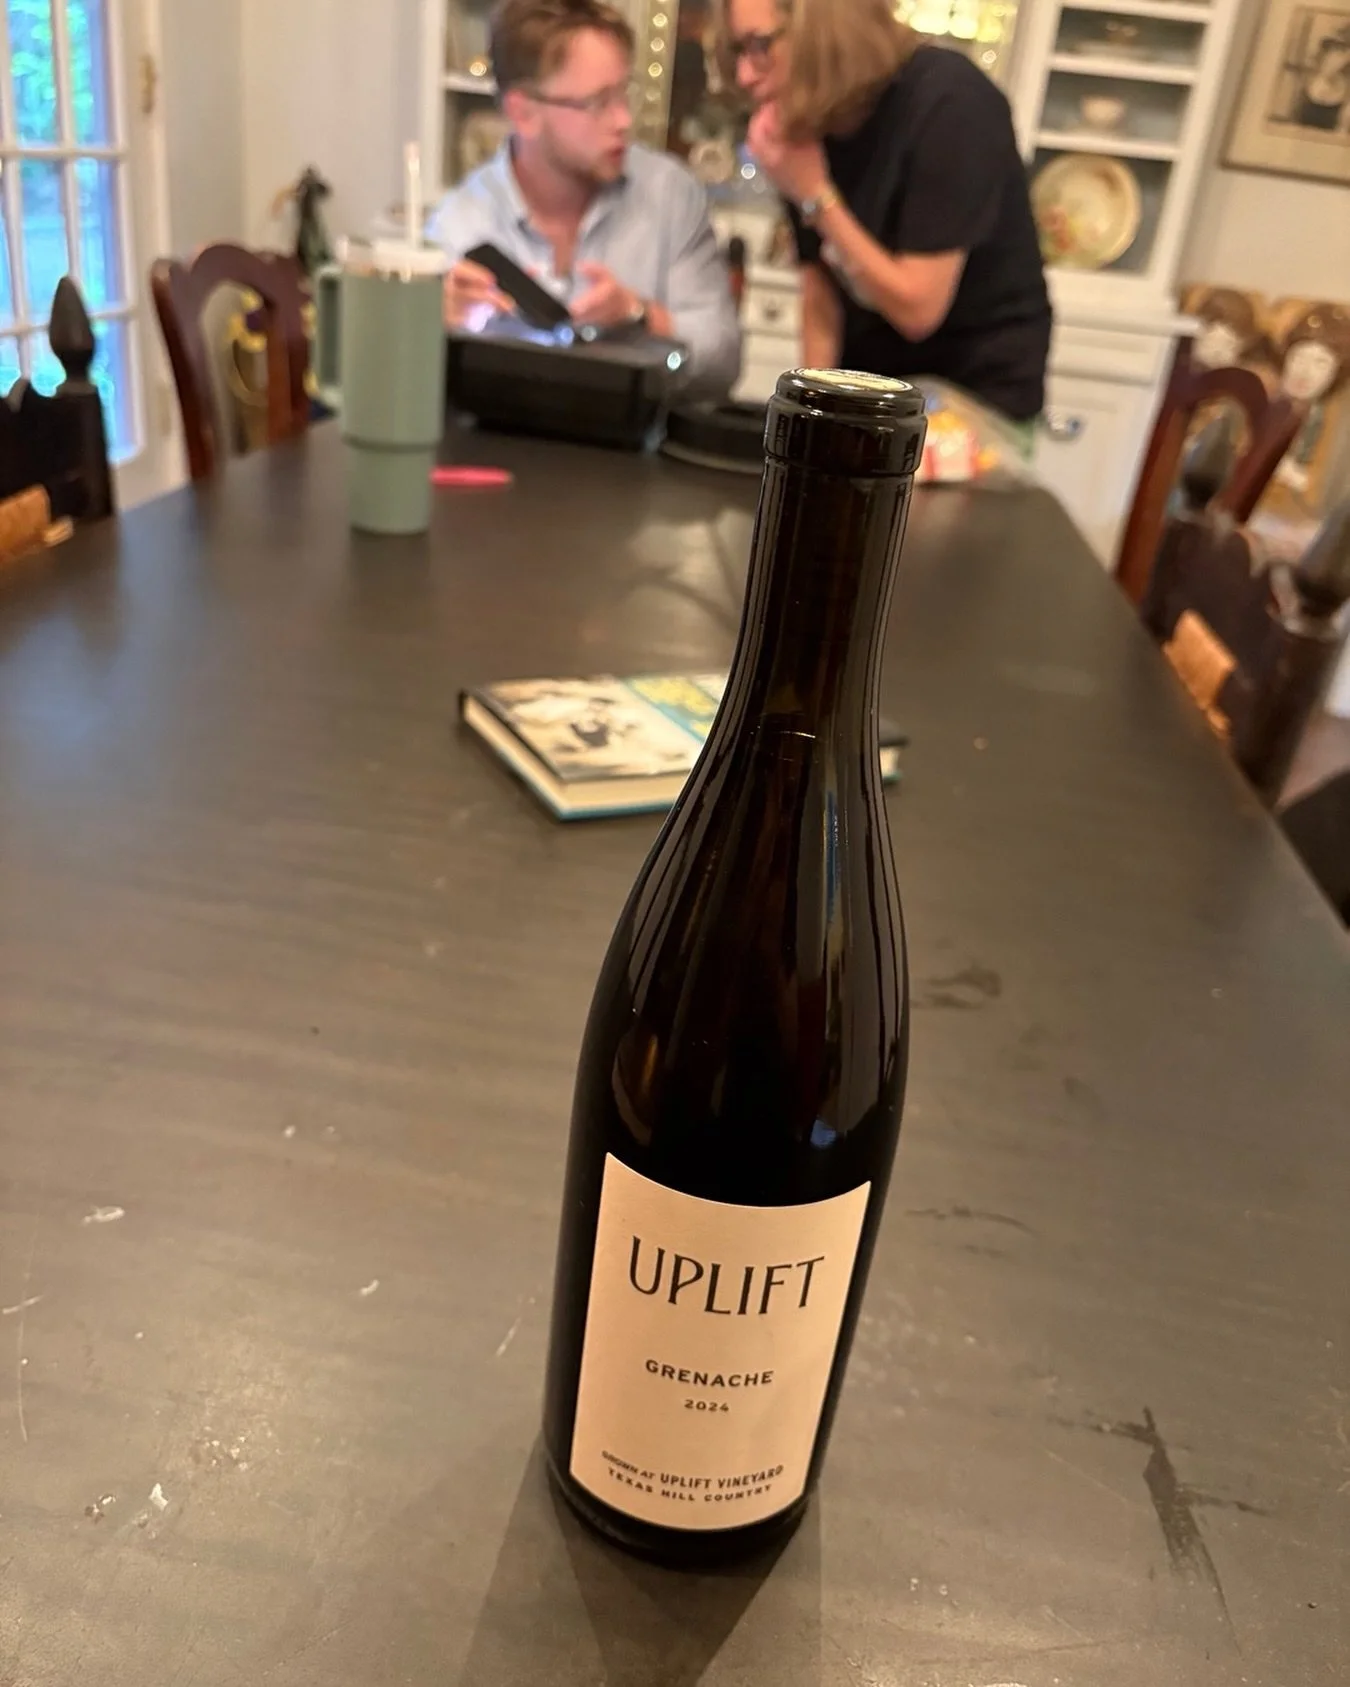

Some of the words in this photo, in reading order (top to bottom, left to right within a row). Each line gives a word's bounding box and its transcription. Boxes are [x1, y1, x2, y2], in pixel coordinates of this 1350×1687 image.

[629, 1234, 825, 1315] UPLIFT
[645, 1359, 774, 1388] GRENACHE
[684, 1399, 730, 1413] 2024
[608, 1467, 653, 1493] TEXAS
[661, 1489, 696, 1502] HILL
[704, 1484, 773, 1502] COUNTRY
[640, 1469, 656, 1480] AT
[660, 1472, 712, 1489] UPLIFT
[717, 1464, 784, 1489] VINEYARD
